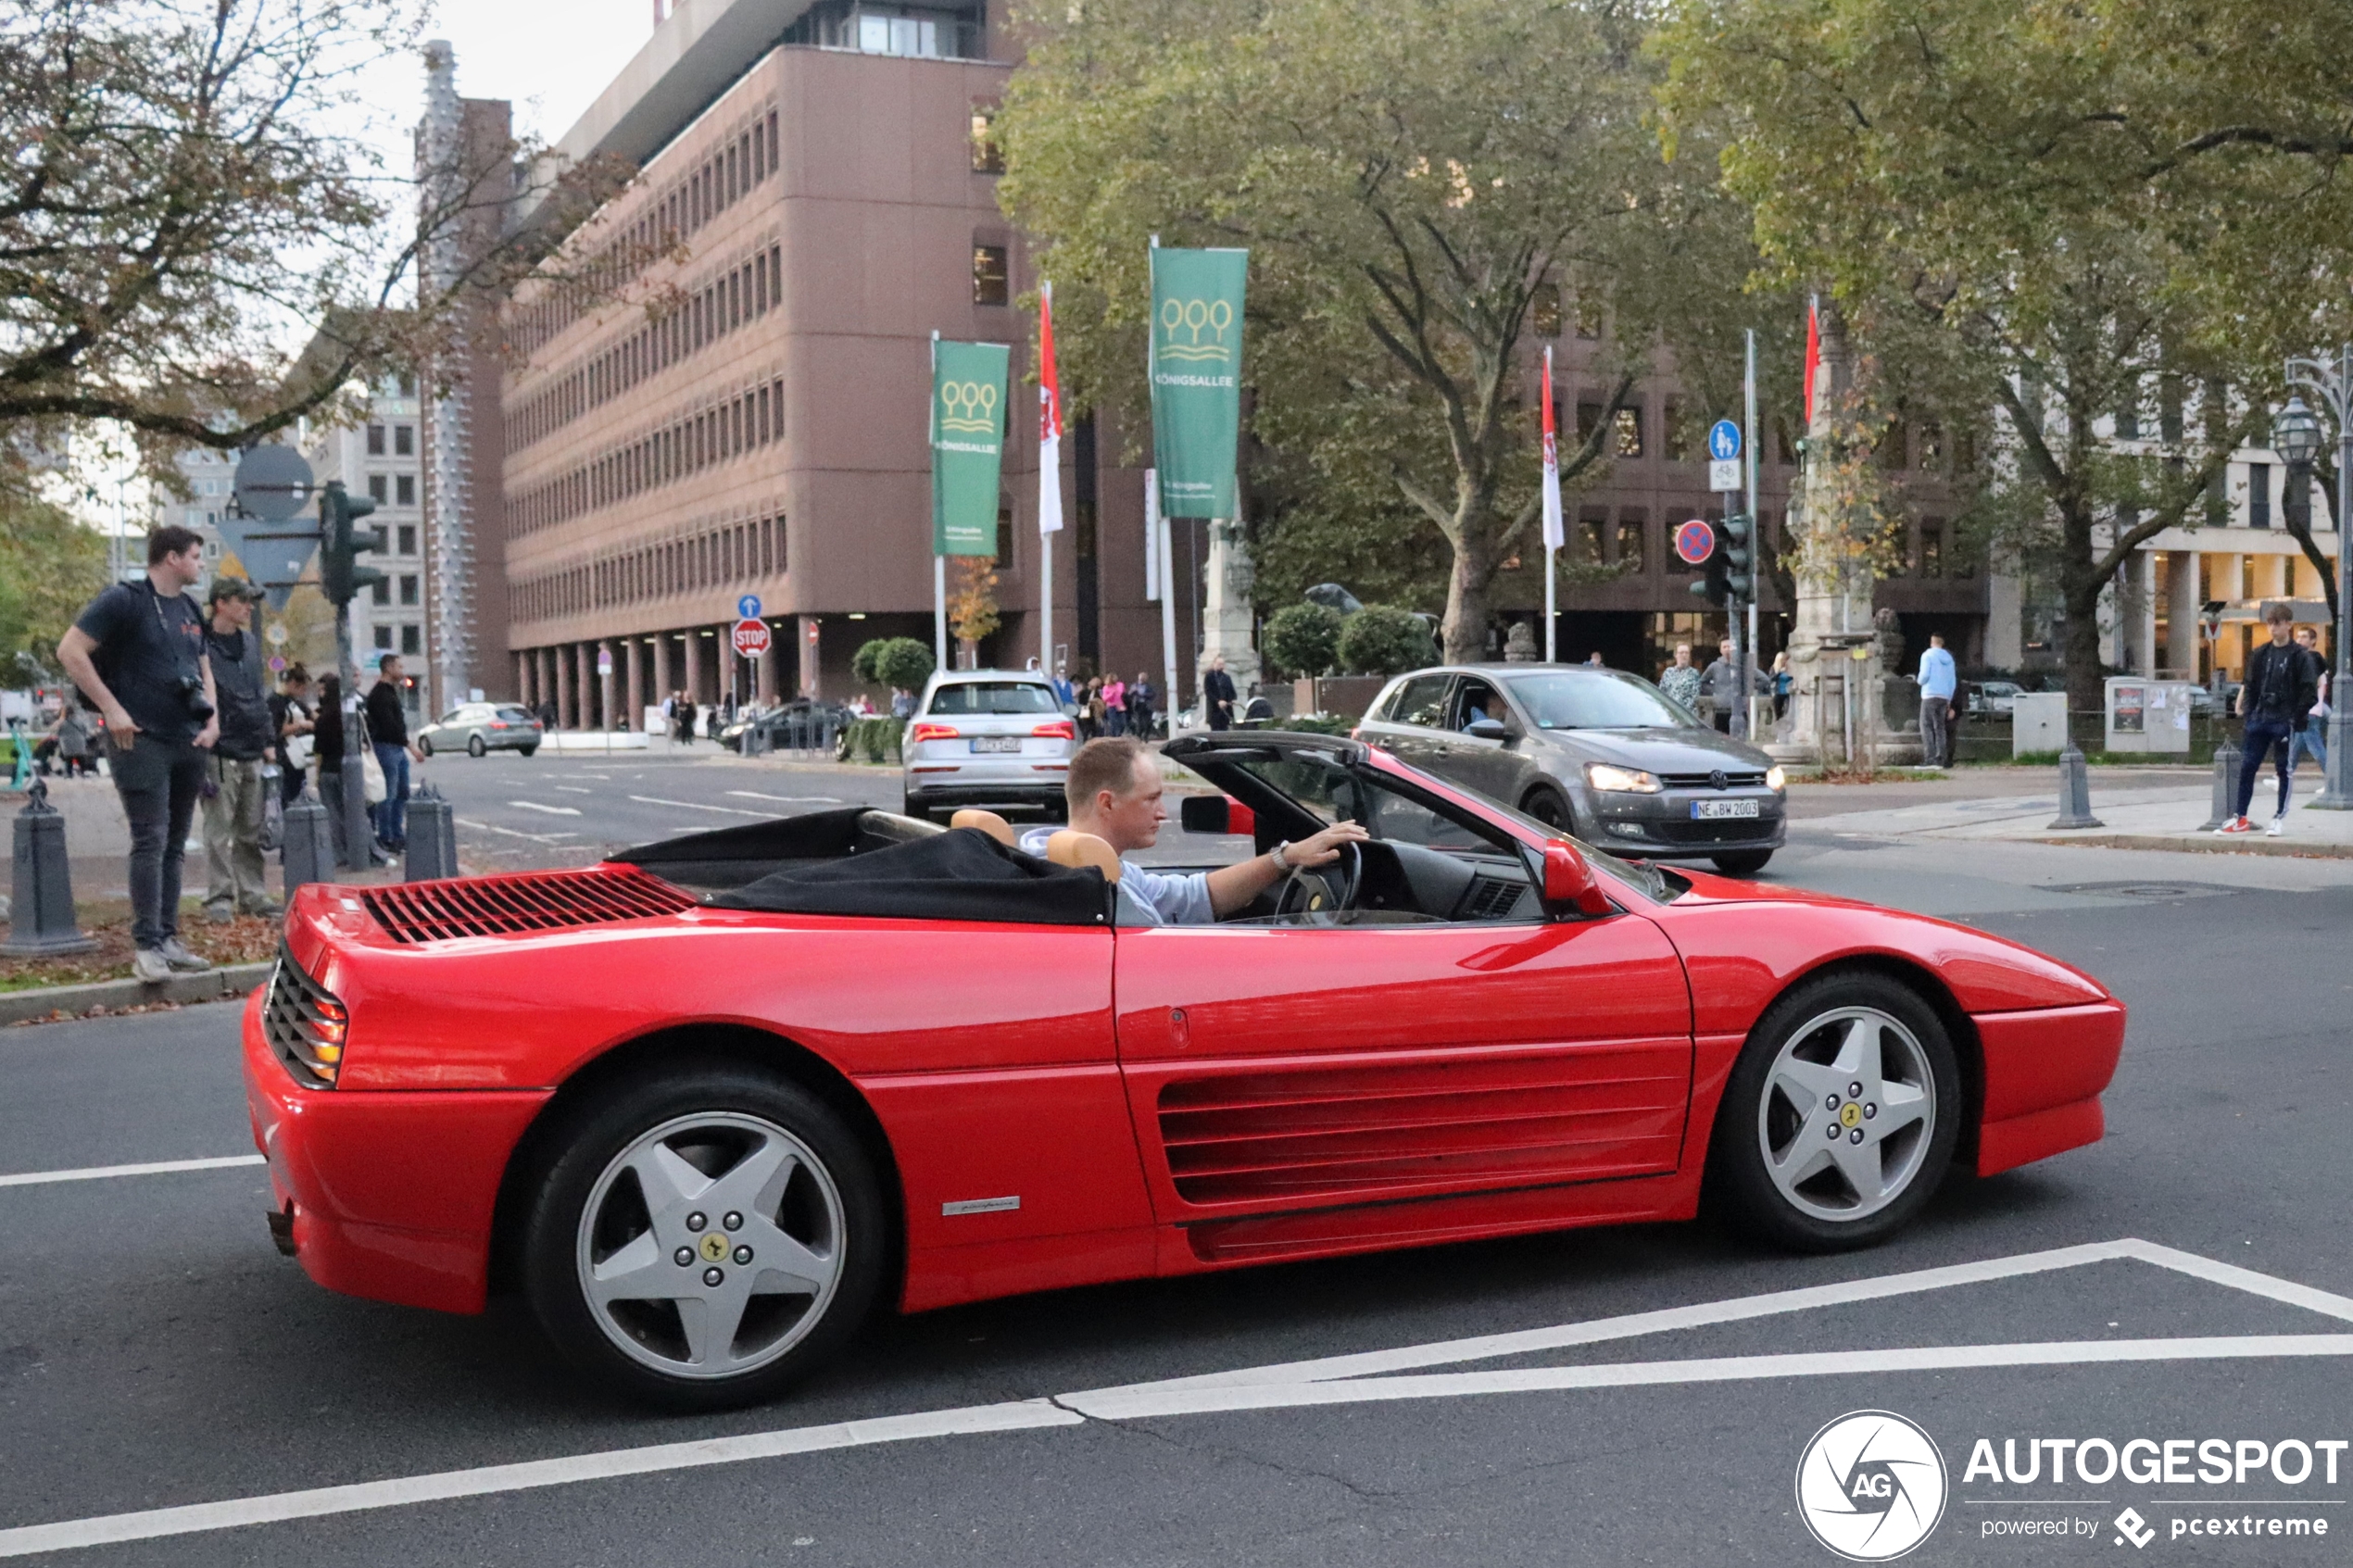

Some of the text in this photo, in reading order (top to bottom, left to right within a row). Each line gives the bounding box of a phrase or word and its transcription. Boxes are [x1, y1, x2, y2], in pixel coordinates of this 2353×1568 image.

[736, 631, 765, 646] STOP
[1698, 802, 1757, 817] NE BW 2003
